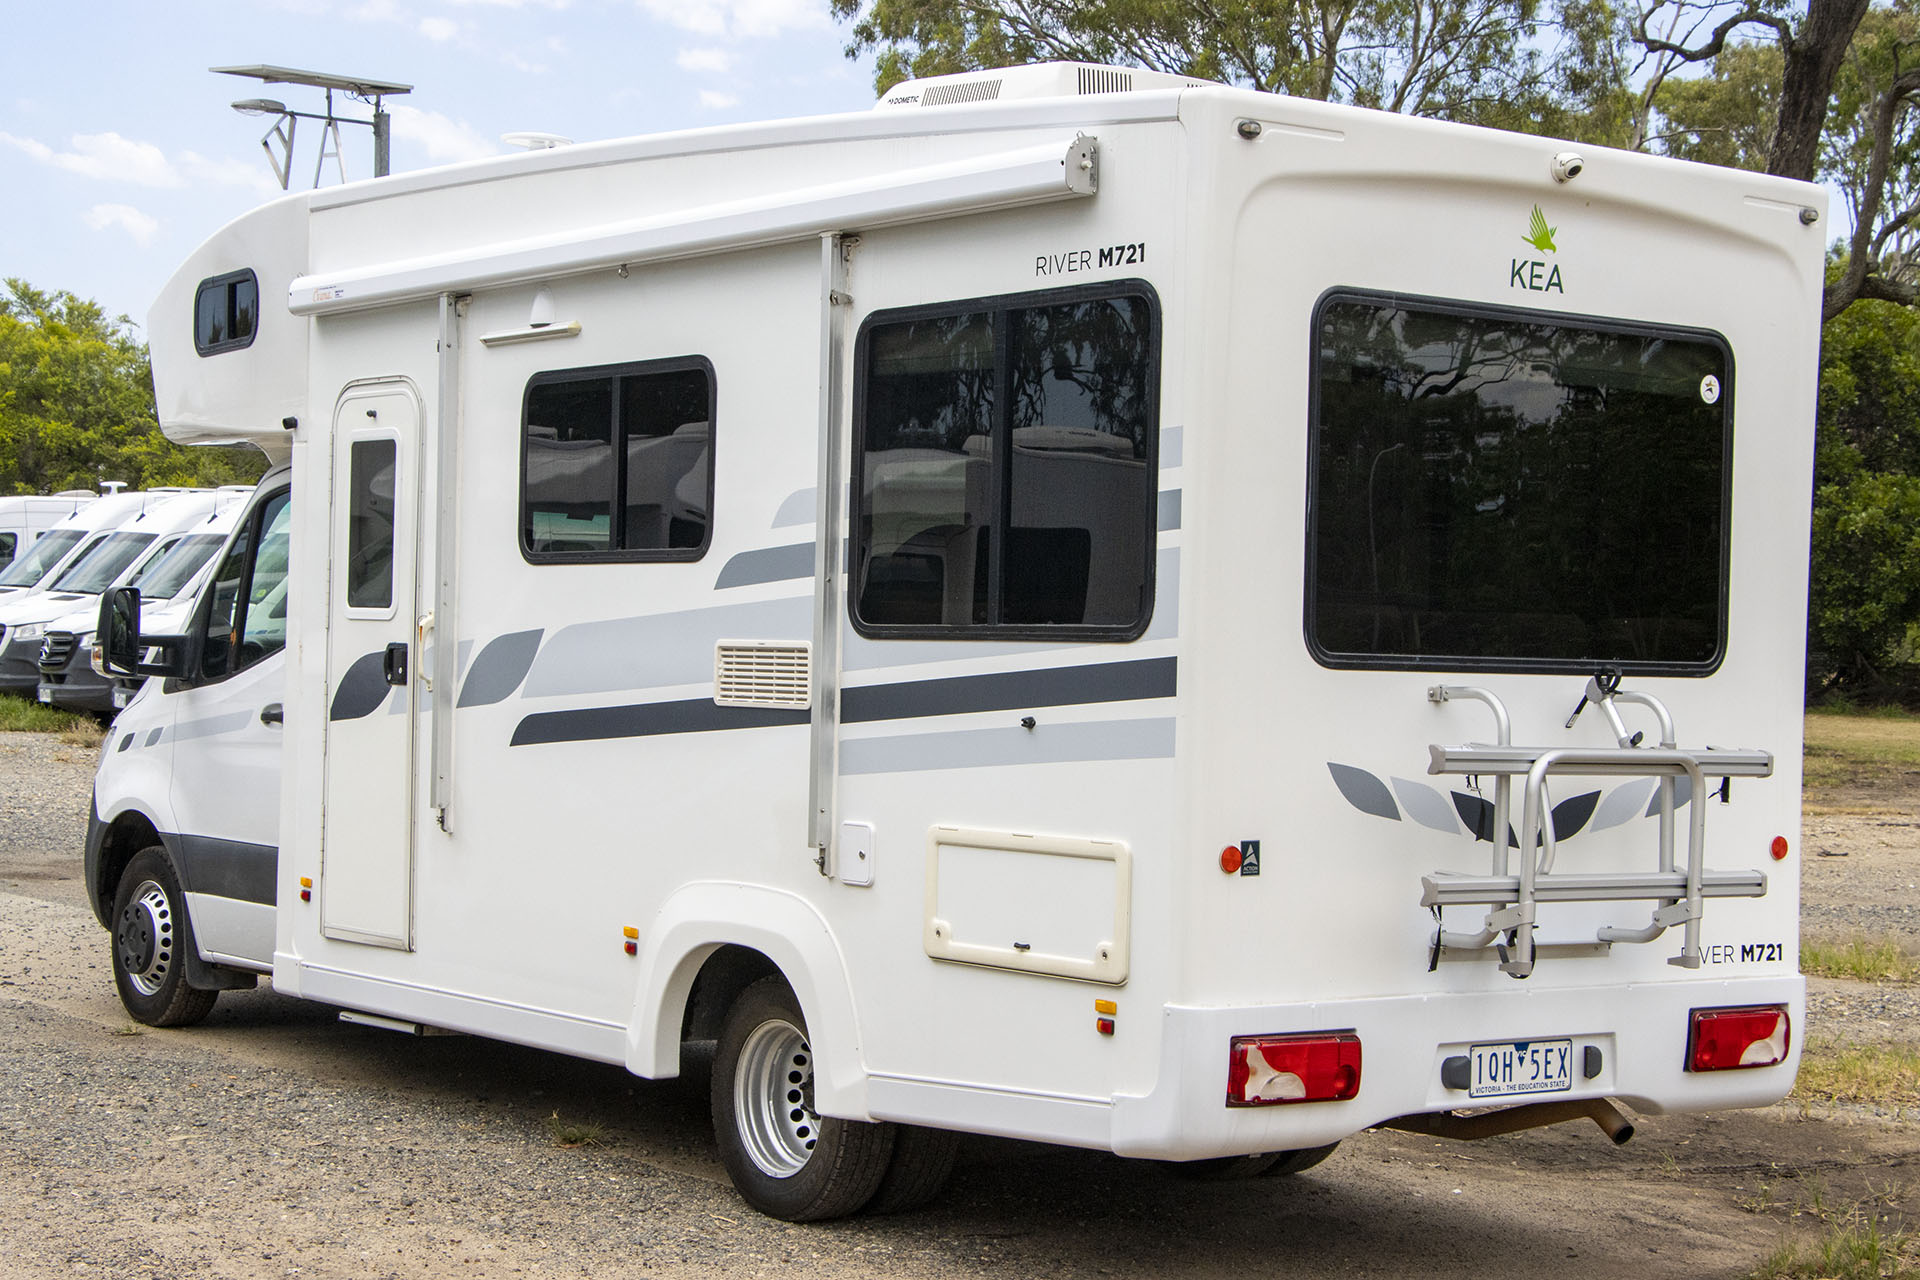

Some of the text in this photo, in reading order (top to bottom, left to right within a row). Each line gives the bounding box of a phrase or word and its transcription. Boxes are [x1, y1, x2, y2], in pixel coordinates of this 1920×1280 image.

[893, 95, 919, 104] DOMETIC
[1035, 242, 1145, 276] RIVER M721
[1510, 258, 1564, 294] KEA
[1681, 943, 1782, 964] VER M721
[1475, 1085, 1501, 1093] VICTORIA
[1518, 1081, 1548, 1090] EDUCATION
[1550, 1080, 1566, 1088] STATE
